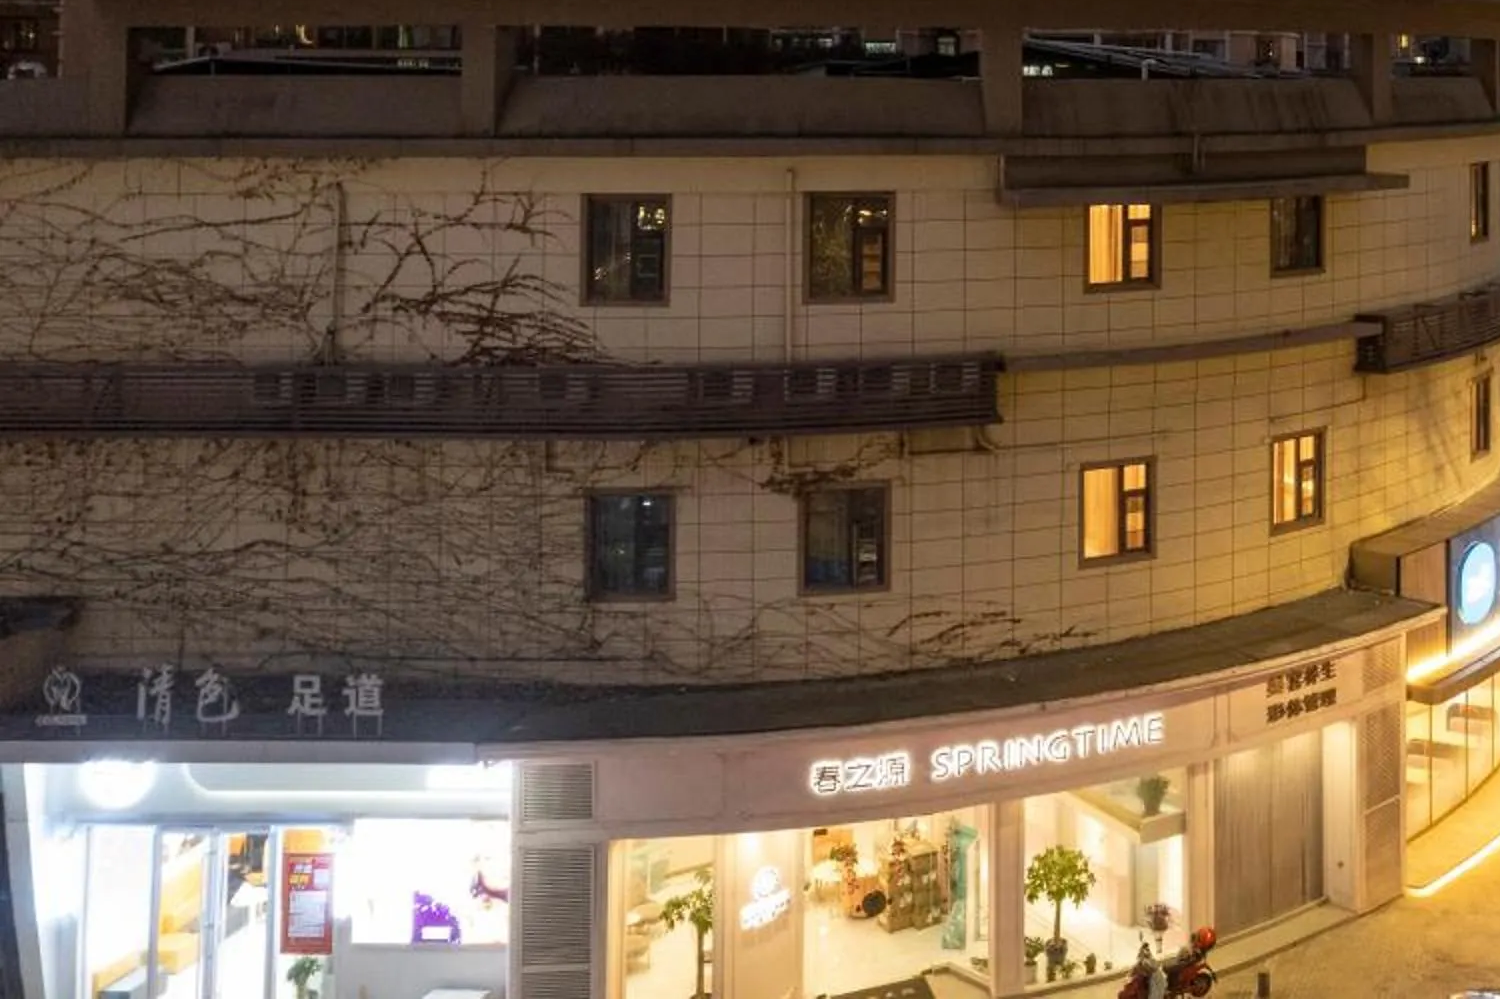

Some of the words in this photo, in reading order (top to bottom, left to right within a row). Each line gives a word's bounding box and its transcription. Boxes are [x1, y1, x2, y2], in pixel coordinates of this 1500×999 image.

[288, 674, 384, 715] 足道
[812, 754, 909, 794] 春之源
[931, 713, 1165, 780] SPRINGTIME
